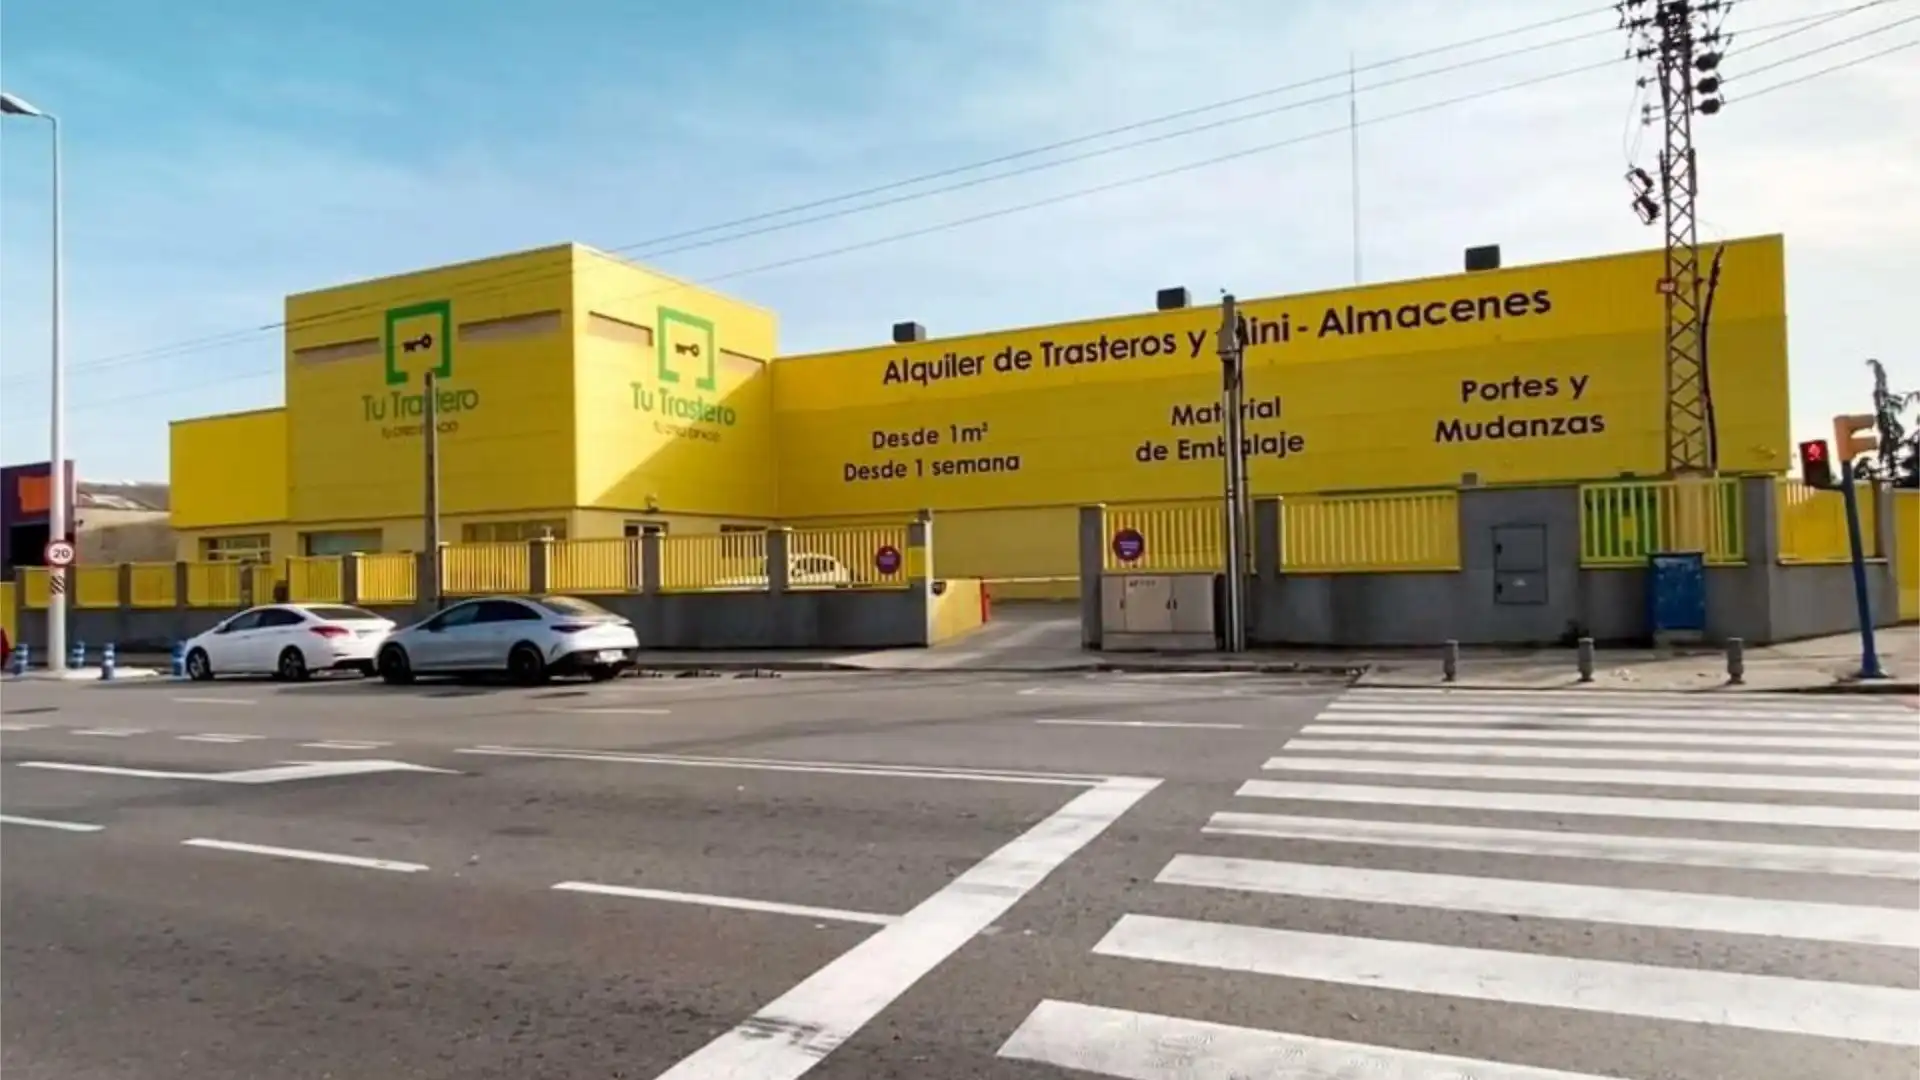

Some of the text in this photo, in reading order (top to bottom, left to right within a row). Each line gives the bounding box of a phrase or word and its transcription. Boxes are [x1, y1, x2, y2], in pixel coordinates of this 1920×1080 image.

[883, 351, 985, 386] Alquiler
[993, 346, 1033, 372] de
[1040, 333, 1176, 367] Trasteros
[1187, 329, 1207, 358] y
[1317, 288, 1552, 339] Almacenes
[1461, 374, 1590, 403] Portes y
[362, 394, 386, 421] Tu
[629, 381, 737, 426] Tu Trastero
[1171, 396, 1282, 427] Matrial
[872, 427, 940, 450] Desde
[1435, 414, 1606, 443] Mudanzas
[1135, 440, 1168, 462] de
[843, 455, 1021, 482] Desde 1 semana
[53, 548, 70, 559] 20
